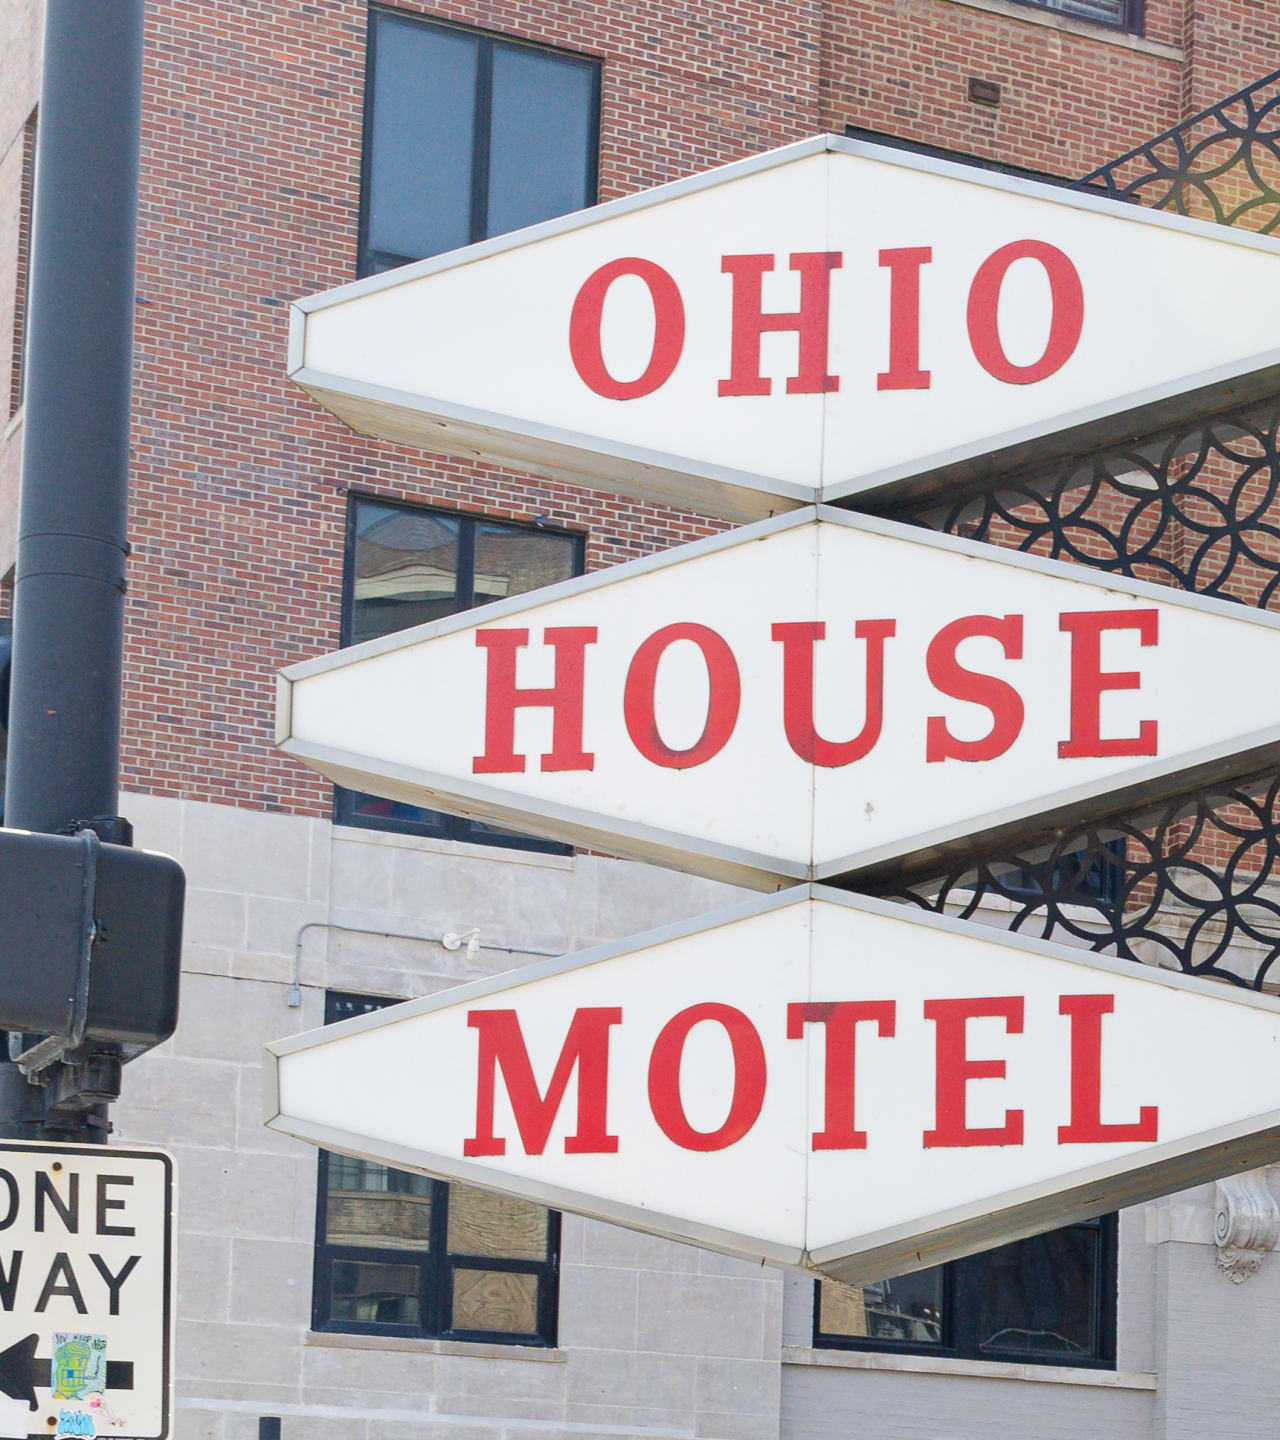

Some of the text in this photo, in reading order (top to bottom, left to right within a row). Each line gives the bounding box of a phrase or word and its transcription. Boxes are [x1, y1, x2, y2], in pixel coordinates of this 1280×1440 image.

[569, 239, 1085, 399] OHIO
[472, 608, 1160, 773] HOUSE
[463, 994, 1159, 1157] MOTEL
